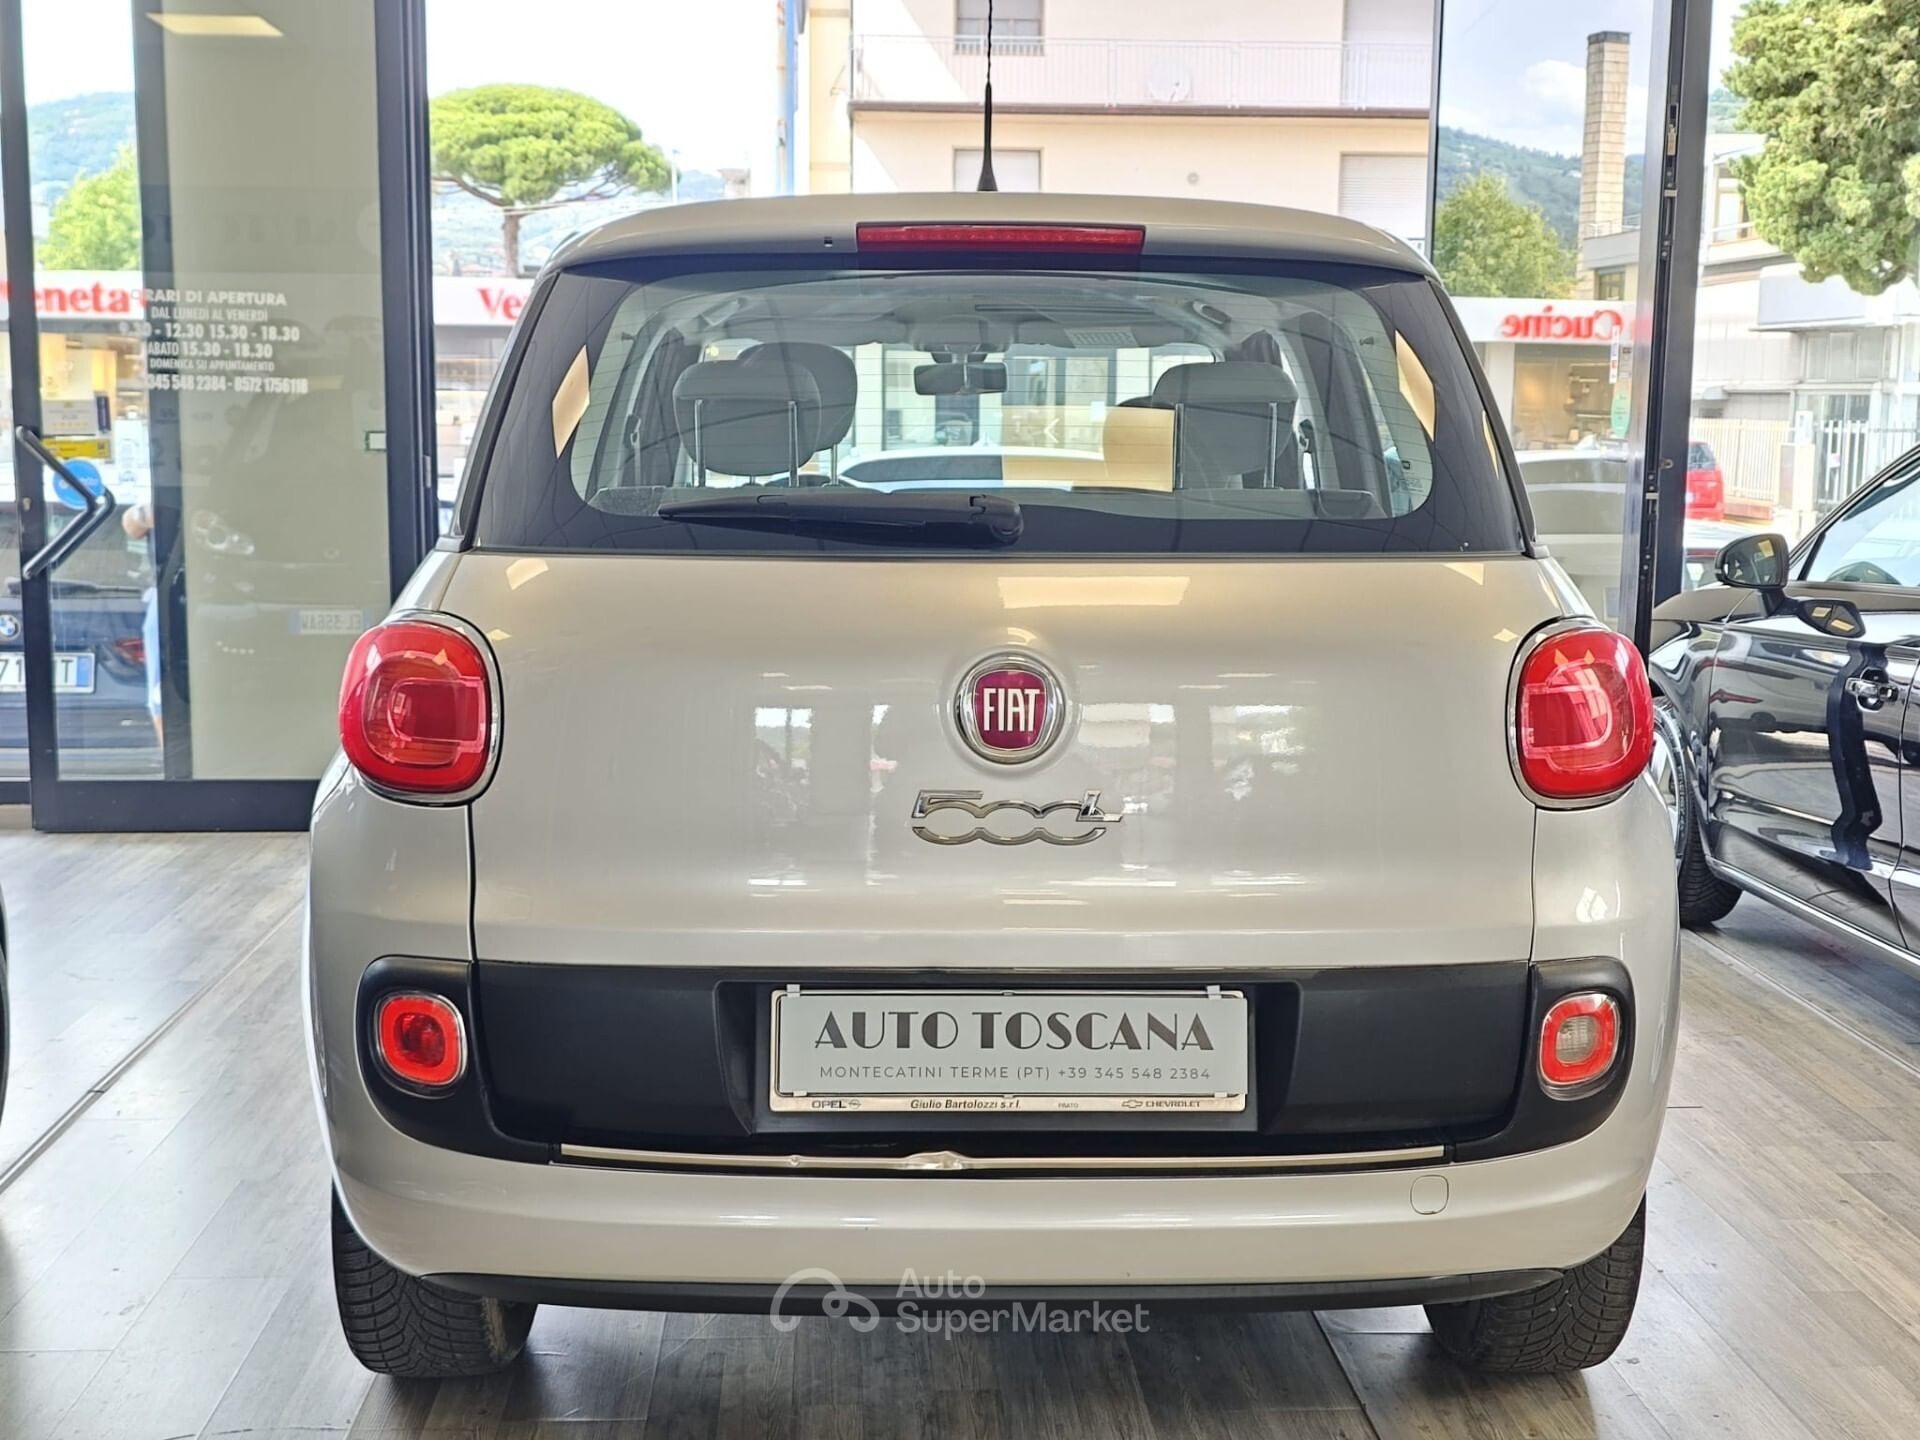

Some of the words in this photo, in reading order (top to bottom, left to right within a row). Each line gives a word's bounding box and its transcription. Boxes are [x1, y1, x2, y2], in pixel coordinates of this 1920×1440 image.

[186, 290, 201, 303] DI
[207, 291, 287, 306] APERTURA
[476, 287, 528, 320] Ve
[151, 306, 170, 319] DAL
[212, 309, 224, 321] AL
[165, 322, 204, 338] 12.30
[209, 323, 248, 340] 15.30
[261, 325, 300, 341] 18.30
[147, 341, 179, 356] ABATO
[182, 341, 221, 357] 15.30
[234, 342, 273, 358] 18.30
[150, 358, 194, 370] DOMENICA
[209, 360, 275, 372] APPUNTAMENTO
[983, 687, 1041, 732] FIAT
[911, 790, 1123, 846] 500L
[814, 1010, 959, 1050] AUTO
[971, 1011, 1214, 1051] TOSCANA
[819, 1065, 943, 1079] MONTECATINI
[950, 1065, 1009, 1079] TERME
[1017, 1066, 1050, 1081] (PT)
[1058, 1066, 1087, 1080] +39
[1094, 1066, 1125, 1080] 345
[1131, 1067, 1163, 1080] 548
[1169, 1067, 1211, 1080] 2384
[811, 1099, 848, 1110] OPEL
[910, 1098, 942, 1110] Giulio
[944, 1098, 998, 1110] Bartolozzi
[1144, 1099, 1201, 1109] CHEVROLET
